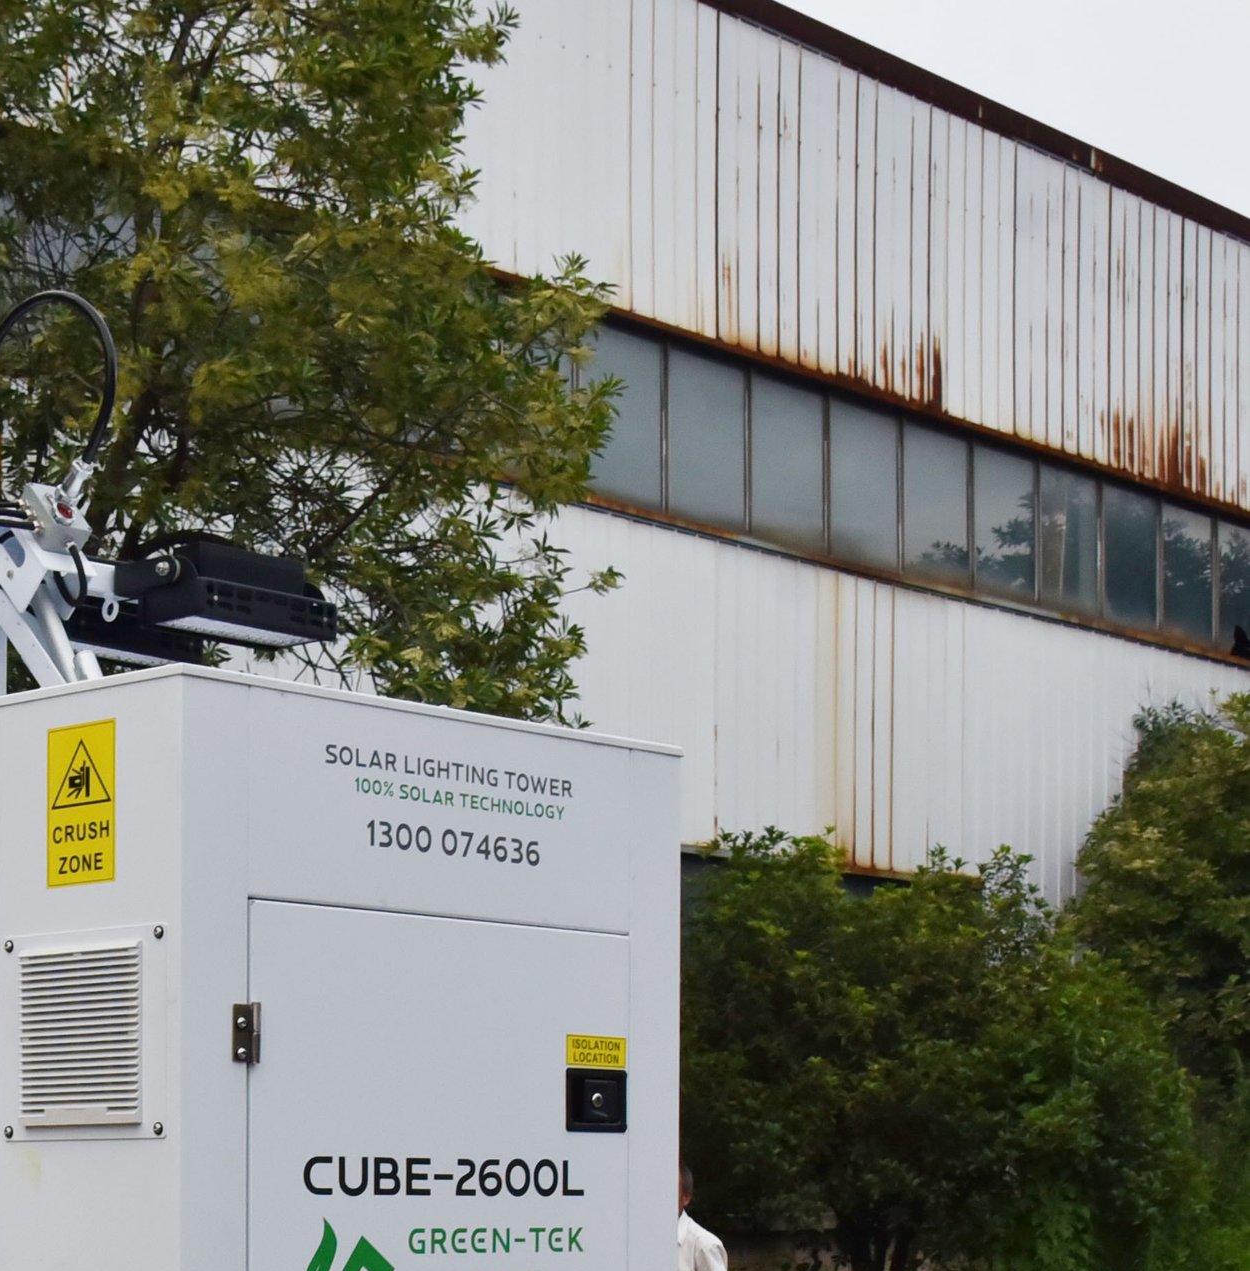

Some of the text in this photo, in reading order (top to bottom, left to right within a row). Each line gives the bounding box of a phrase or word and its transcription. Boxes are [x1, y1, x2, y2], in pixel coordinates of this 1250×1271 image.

[325, 744, 573, 798] SOLAR LIGHTING TOWER
[354, 777, 565, 821] 100% SOLAR TECHNOLOGY
[52, 819, 110, 844] CRUSH
[366, 819, 541, 867] 1300 074636
[58, 852, 103, 875] ZONE
[572, 1038, 621, 1052] ISOLATION
[573, 1051, 620, 1064] LOCATION
[303, 1155, 584, 1197] CUBE-2600L
[408, 1226, 584, 1254] GREEN-TEK
